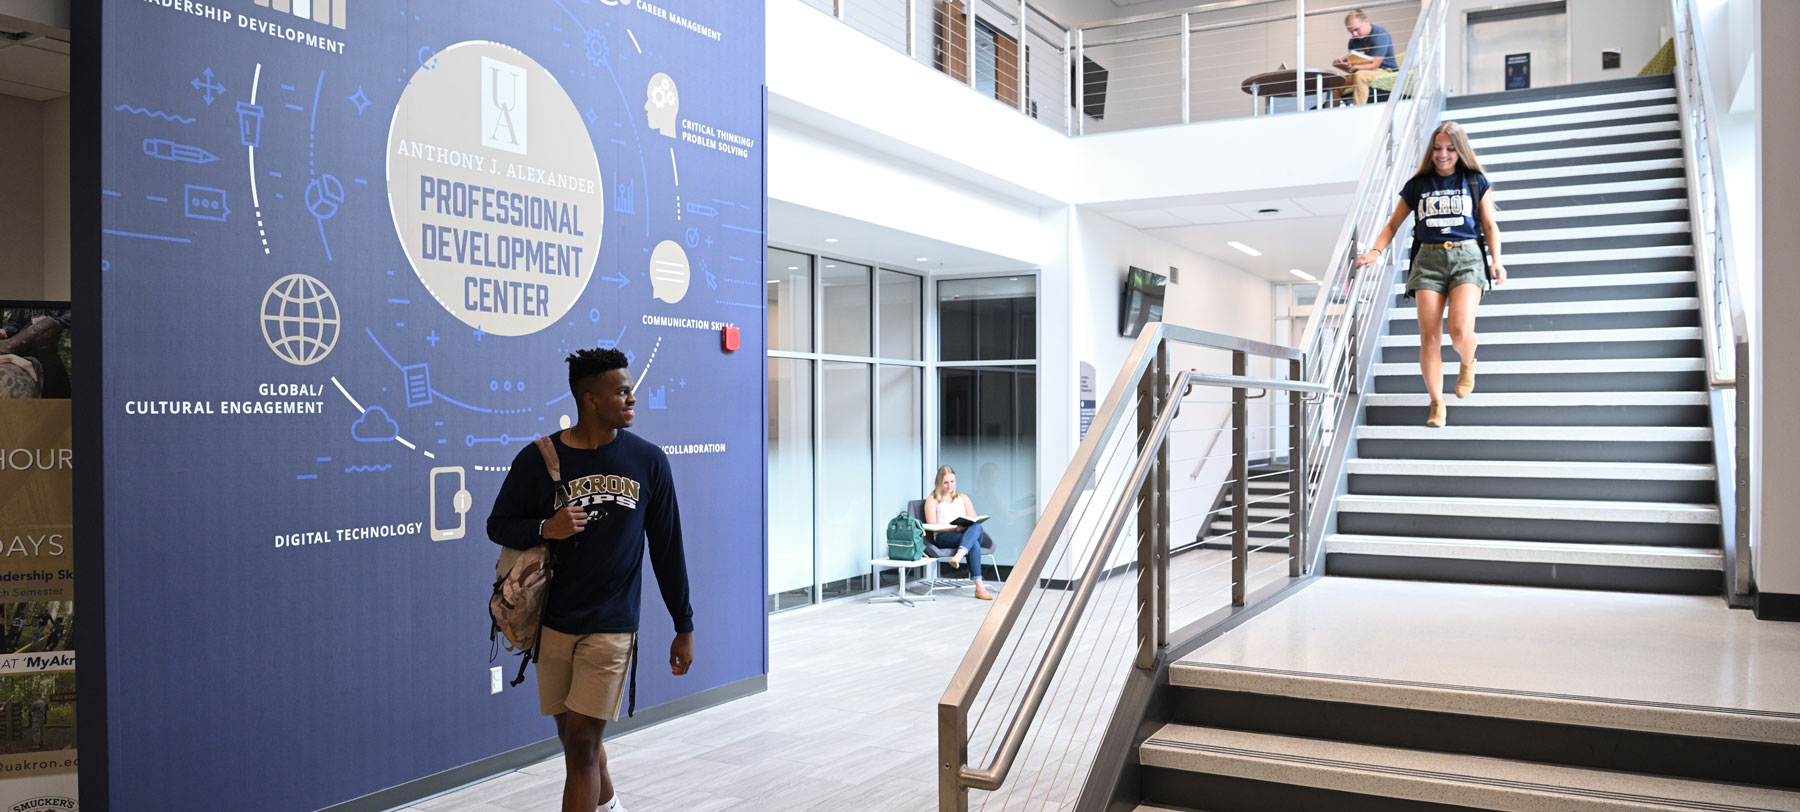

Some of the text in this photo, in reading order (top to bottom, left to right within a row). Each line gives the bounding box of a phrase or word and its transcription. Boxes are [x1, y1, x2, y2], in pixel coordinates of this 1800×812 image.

[144, 0, 345, 54] DERSHIP DEVELOPMENT
[636, 0, 722, 42] CAREER MANAGEMENT
[682, 119, 754, 148] CRITICAL THINKING/
[682, 131, 748, 159] PROBLEM SOLVING
[397, 139, 595, 195] ANTHONY J. ALEXANDER
[420, 175, 584, 237] PROFESSIONAL
[422, 223, 583, 278] DEVELOPMENT
[464, 276, 549, 317] CENTER
[642, 314, 709, 330] COMMUNICATION
[259, 383, 324, 397] GLOBAL/
[125, 401, 324, 415] CULTURAL ENGAGEMENT
[568, 494, 637, 509] IPS
[0, 534, 64, 557] AYS
[274, 522, 423, 548] DIGITAL TECHNOLOGY
[13, 588, 63, 597] Semester
[1, 658, 19, 669] AT
[13, 798, 75, 812] SMUCKER'S
